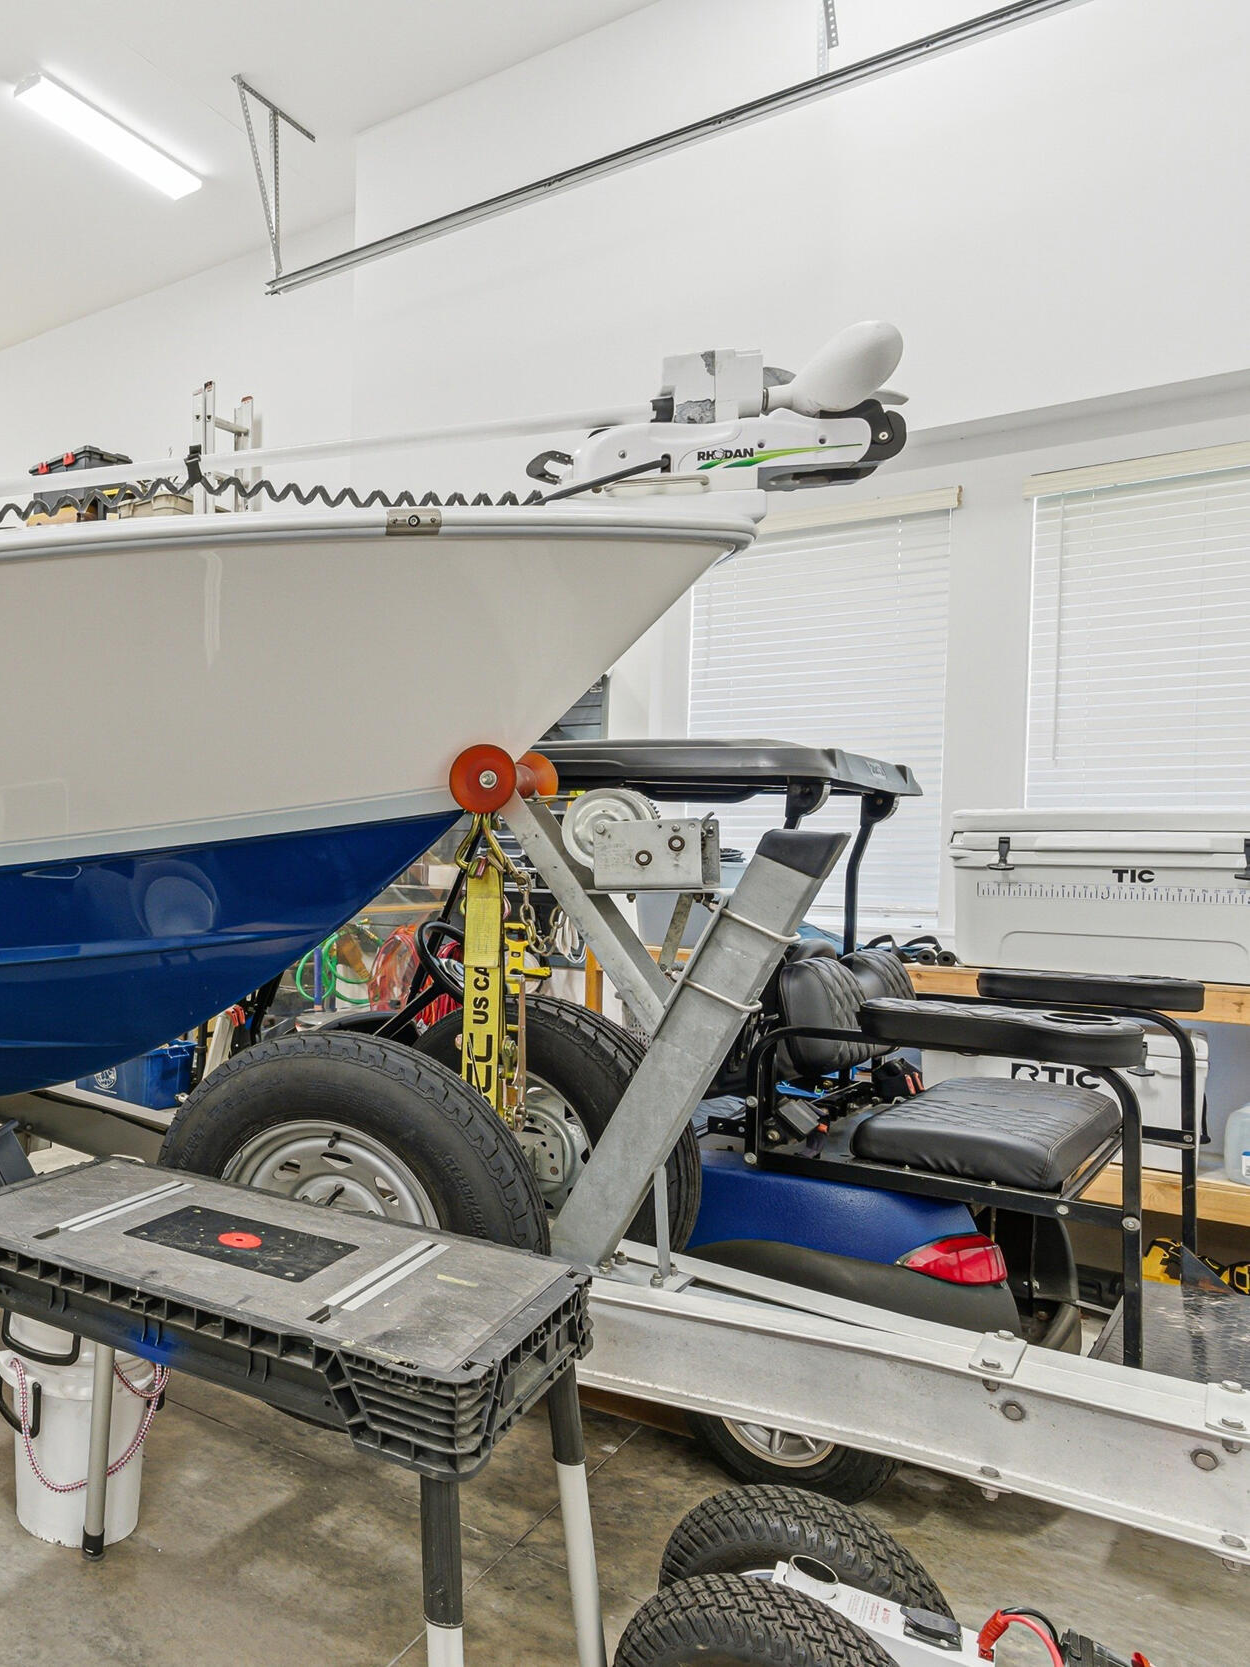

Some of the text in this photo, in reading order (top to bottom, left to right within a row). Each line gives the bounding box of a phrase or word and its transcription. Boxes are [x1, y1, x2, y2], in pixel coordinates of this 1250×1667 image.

[1112, 869, 1155, 884] TIC
[472, 967, 490, 992] CA
[473, 996, 490, 1025] US
[1011, 1063, 1101, 1090] RTIC
